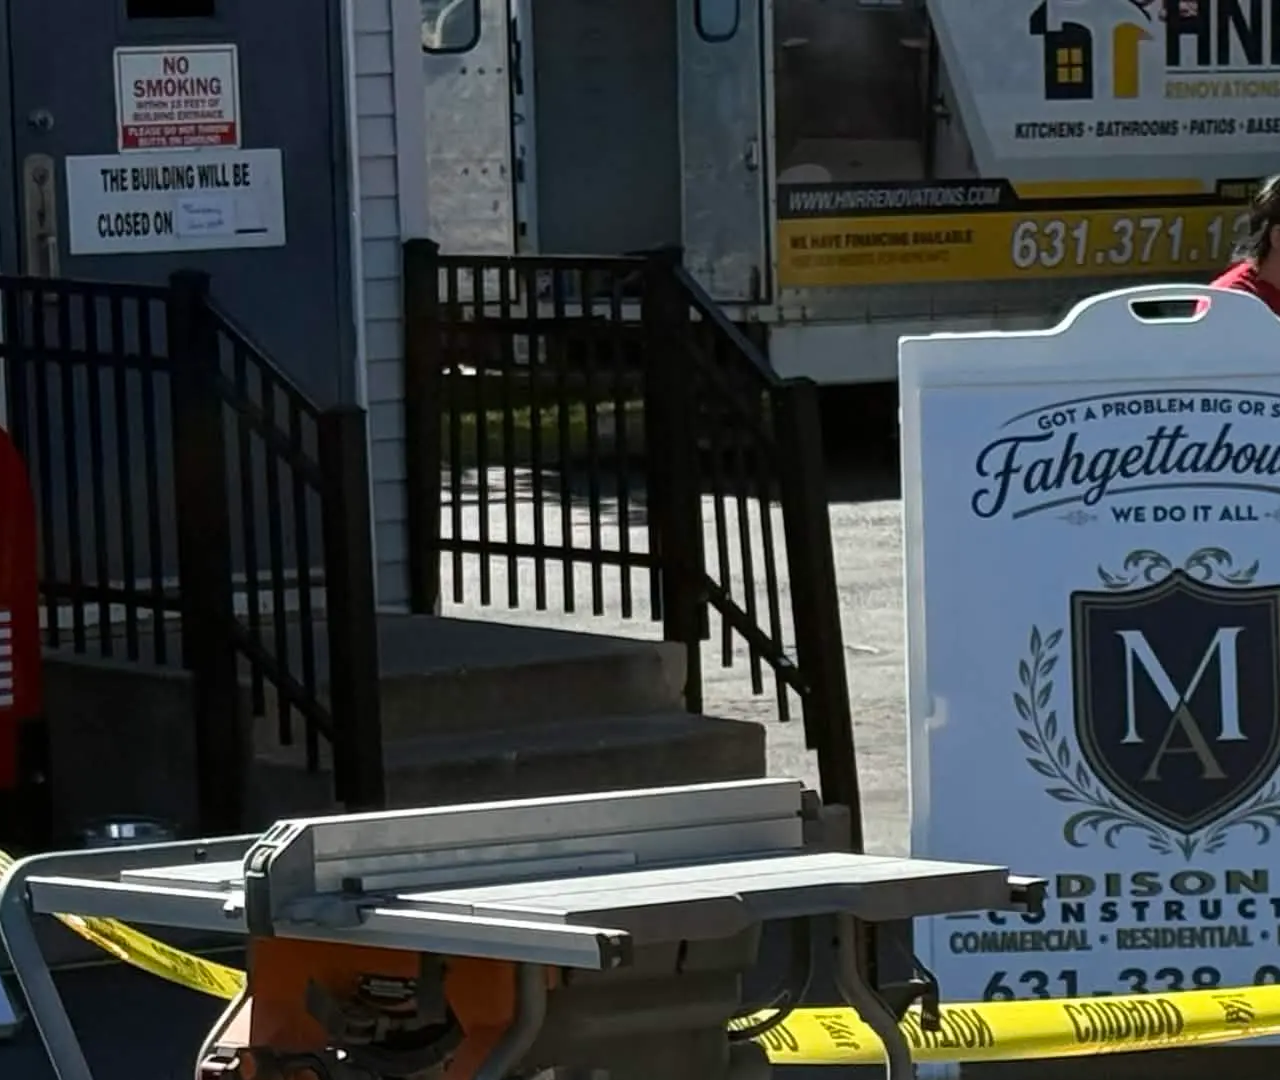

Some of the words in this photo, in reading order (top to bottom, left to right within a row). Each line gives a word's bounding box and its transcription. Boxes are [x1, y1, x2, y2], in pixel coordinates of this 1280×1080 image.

[163, 56, 189, 75] NO
[133, 77, 221, 97] SMOKING
[1015, 120, 1085, 138] KITCHENS
[1096, 119, 1179, 137] BATHROOMS
[1190, 118, 1236, 135] PATIOS
[100, 168, 128, 192] THE
[131, 165, 194, 191] BUILDING
[197, 163, 229, 188] WILL
[232, 163, 250, 187] BE
[789, 187, 1000, 212] WWW.HNRRENOVATIONS.COM
[97, 212, 150, 238] CLOSED
[154, 210, 173, 235] ON
[810, 234, 841, 249] HAVE
[845, 231, 910, 248] FINANCING
[912, 228, 974, 246] AVAILABLE
[1037, 408, 1077, 431] GOT
[1084, 406, 1097, 421] A
[1103, 399, 1194, 419] PROBLEM
[1200, 398, 1233, 414] BIG
[1238, 400, 1266, 416] OR
[1111, 506, 1146, 523] WE
[1160, 505, 1186, 523] DO
[1193, 505, 1212, 522] IT
[1219, 504, 1259, 522] ALL
[1045, 868, 1269, 899] DISON
[949, 929, 1093, 954] COMMERCIAL
[1116, 925, 1254, 951] RESIDENTIAL
